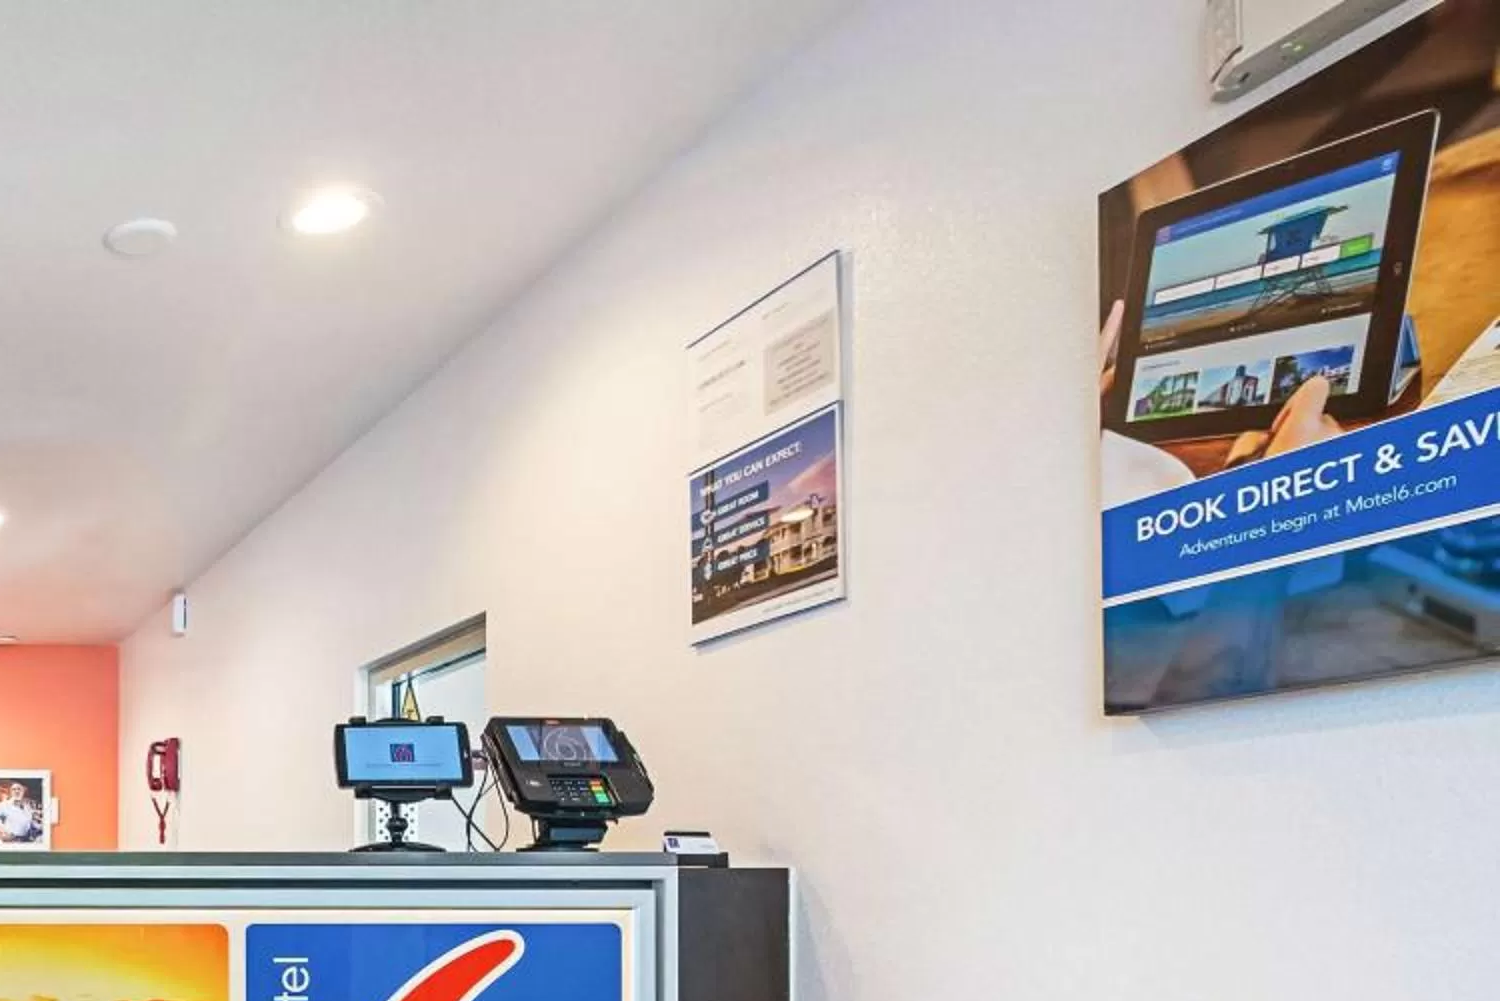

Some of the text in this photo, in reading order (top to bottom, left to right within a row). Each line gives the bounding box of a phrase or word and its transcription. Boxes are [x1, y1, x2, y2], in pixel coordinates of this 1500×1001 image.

[743, 461, 764, 477] CAN
[1135, 411, 1500, 542] BOOK DIRECT & SAV
[1179, 473, 1458, 558] Adventures begin at Motel6.com
